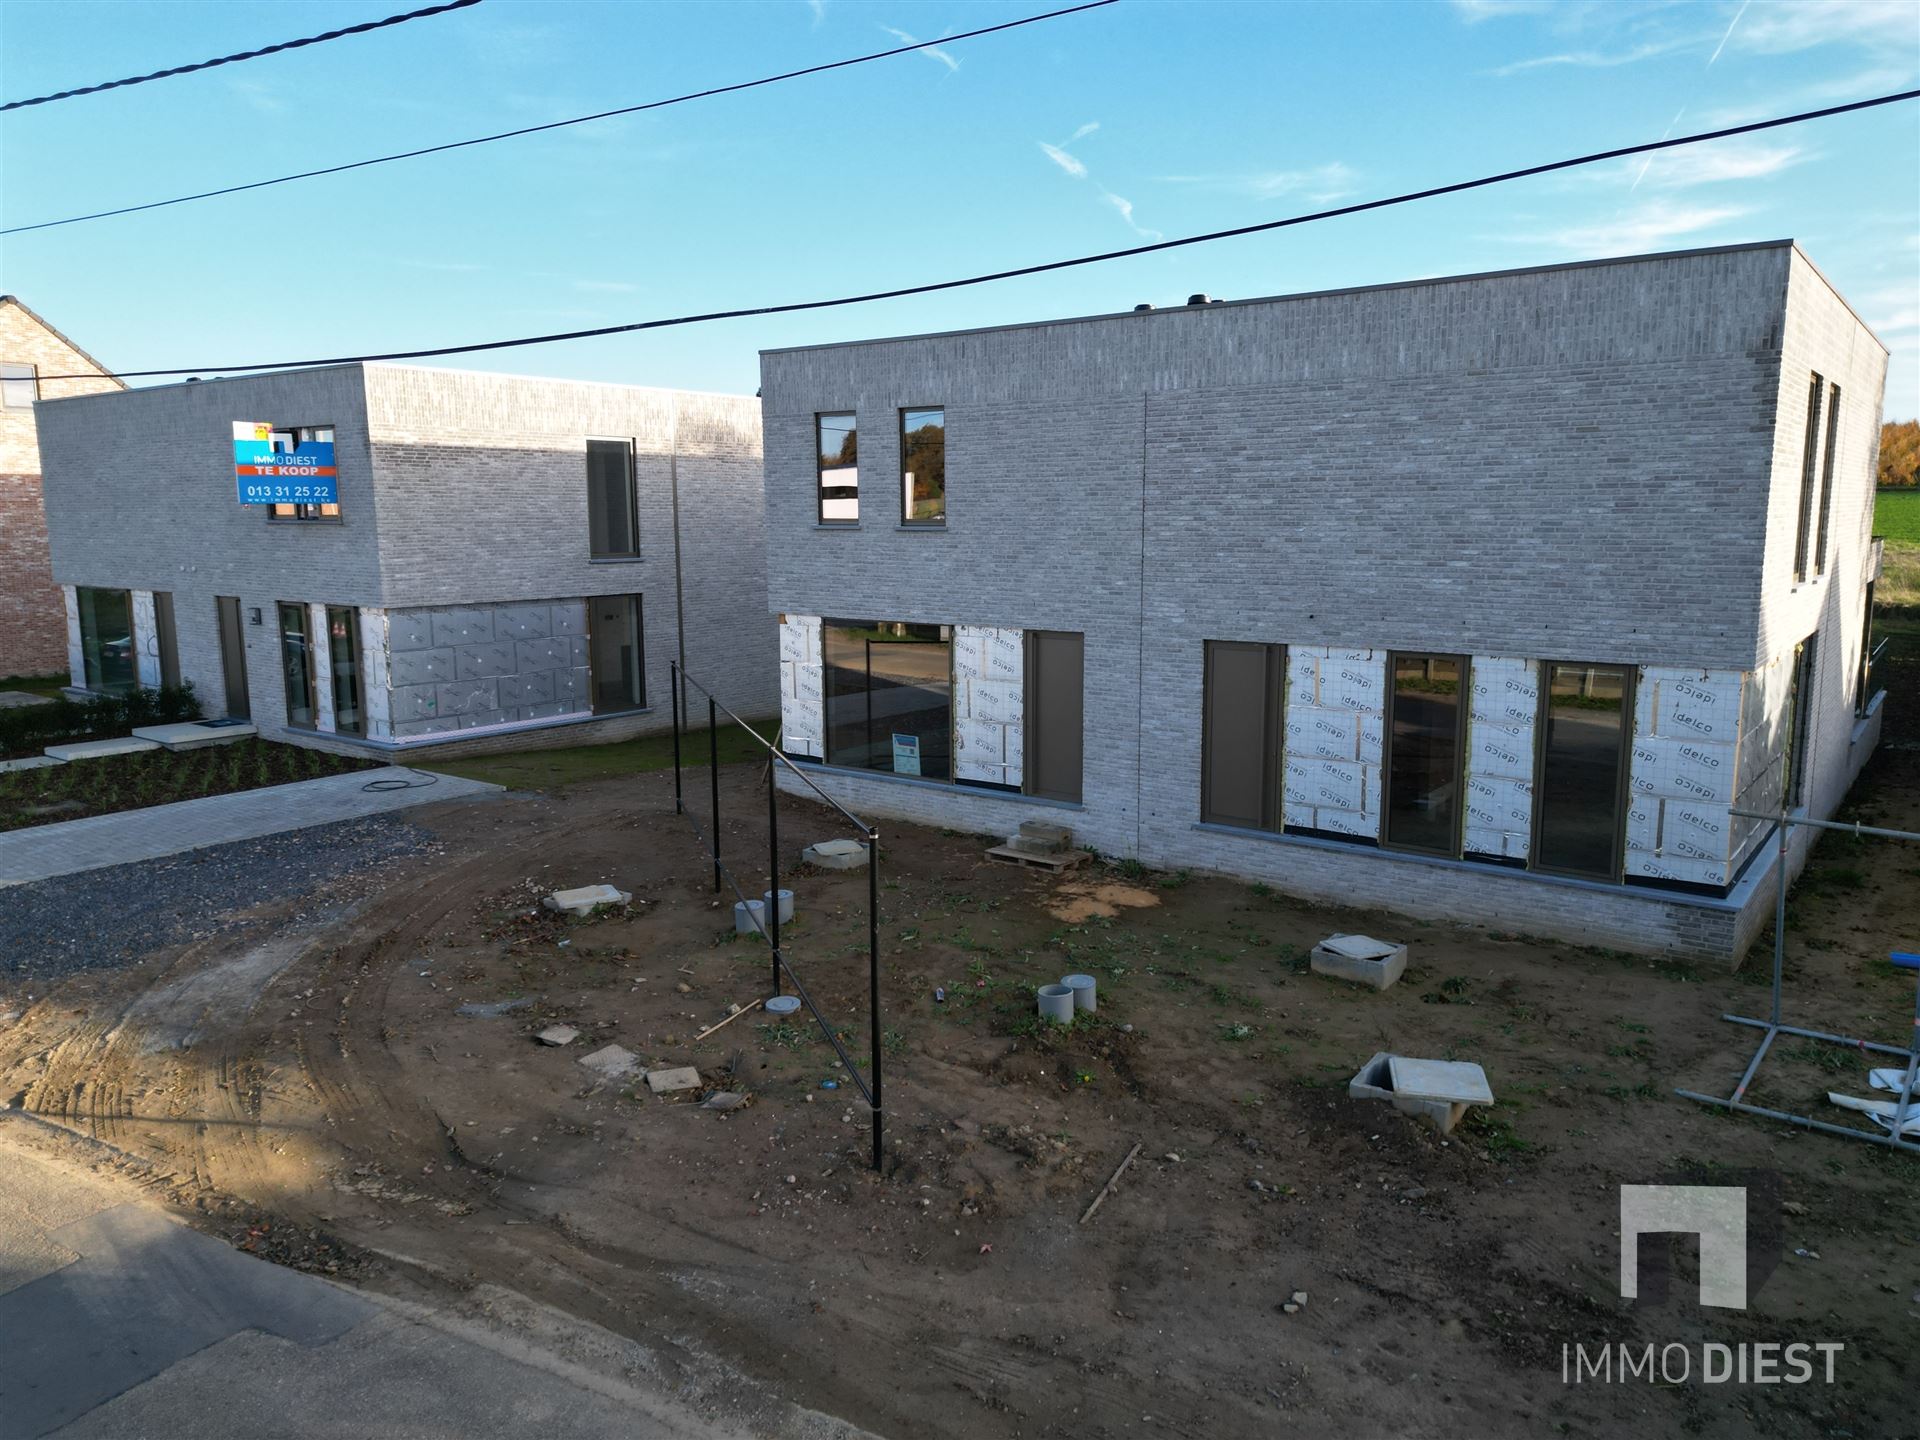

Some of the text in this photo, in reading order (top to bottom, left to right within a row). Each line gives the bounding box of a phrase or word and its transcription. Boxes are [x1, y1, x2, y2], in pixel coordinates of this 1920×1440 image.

[253, 455, 317, 465] IMMO DIEST
[255, 466, 319, 476] TE KOOP
[247, 486, 329, 497] 013 31 25 22
[992, 659, 1015, 673] idelco
[1341, 671, 1372, 689] idelco
[977, 688, 999, 704] idelco
[1675, 684, 1716, 704] idelco
[1315, 721, 1346, 740] idelco
[1672, 711, 1713, 733] idelco
[1484, 745, 1519, 765] idelco
[1679, 745, 1719, 767] idelco
[1322, 763, 1353, 782] idelco
[1675, 778, 1716, 799] idelco
[1320, 790, 1351, 809] idelco
[1329, 818, 1359, 837] idelco
[1679, 810, 1719, 833] idelco
